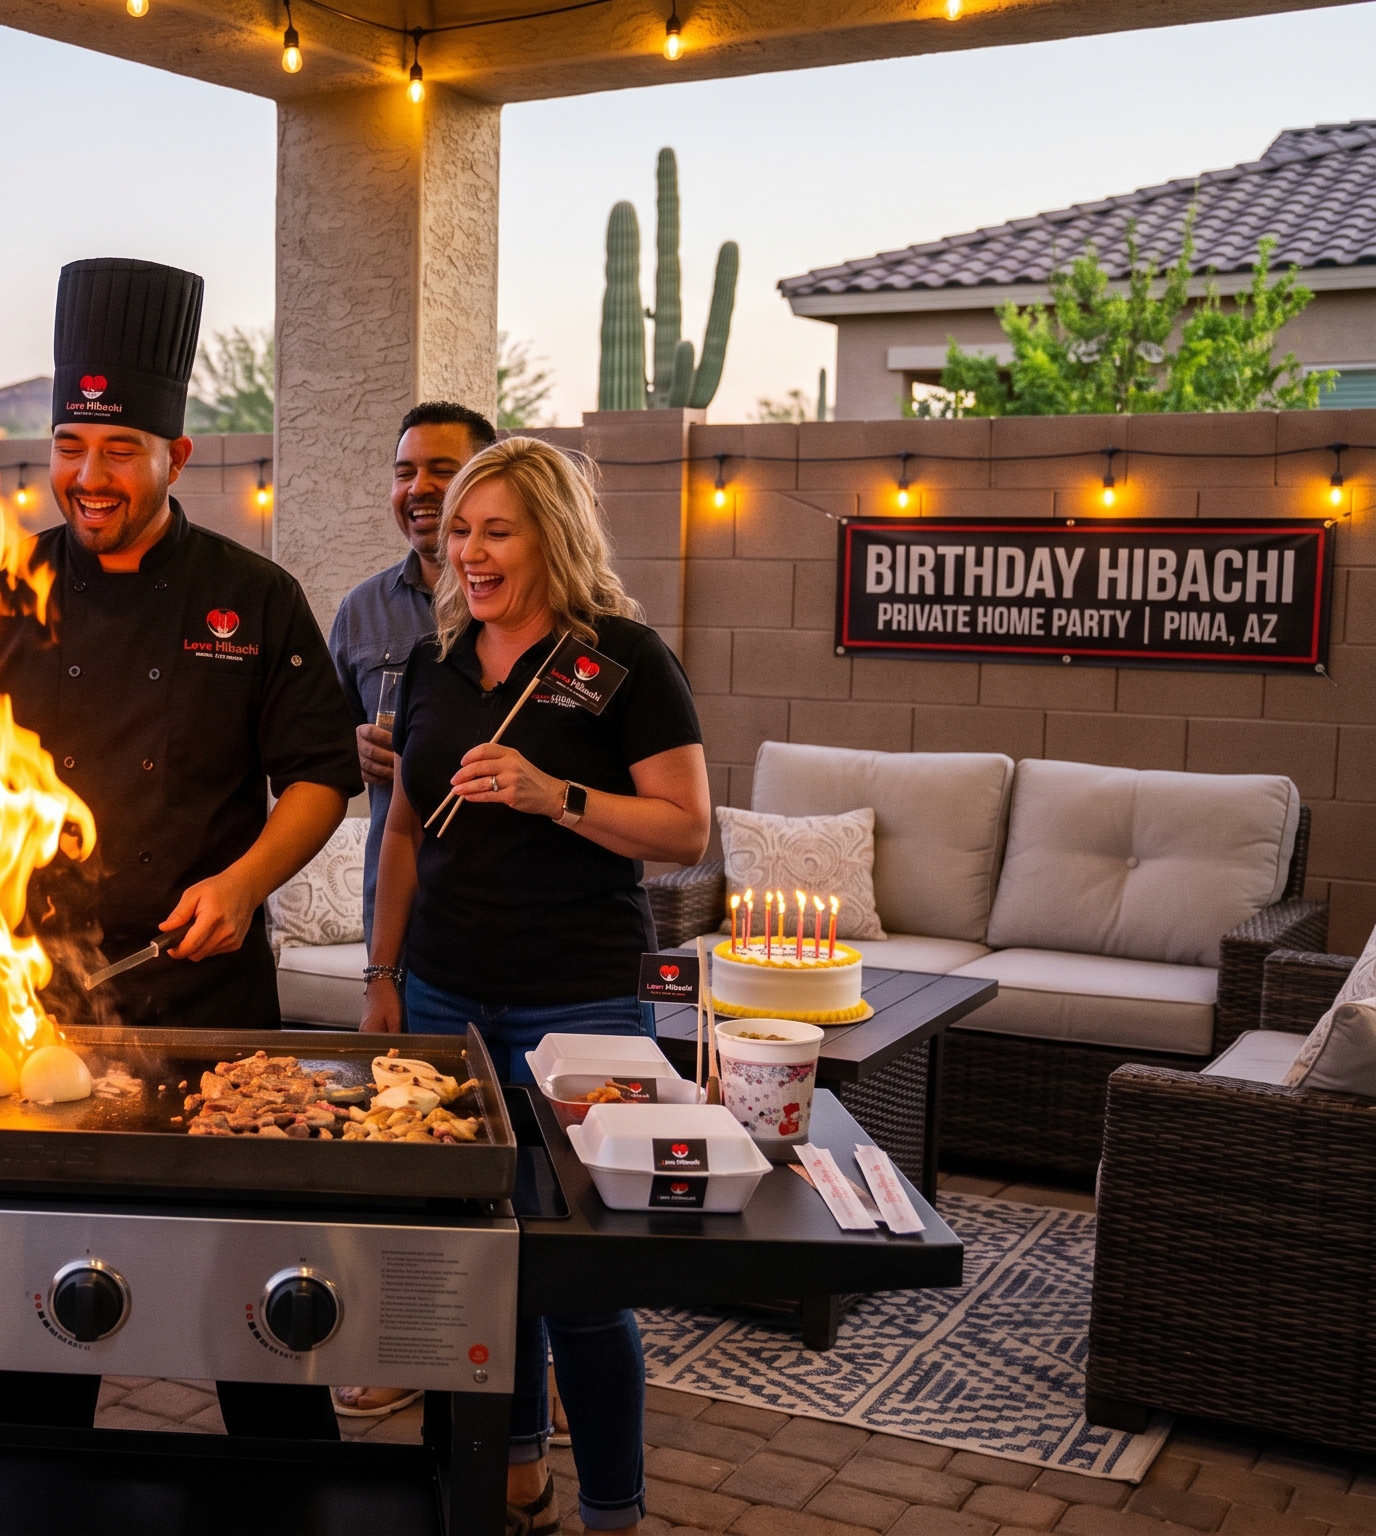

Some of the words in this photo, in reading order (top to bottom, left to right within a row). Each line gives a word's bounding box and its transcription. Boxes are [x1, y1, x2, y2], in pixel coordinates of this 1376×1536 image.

[865, 544, 1085, 599] BIRTHDAY
[1097, 547, 1296, 604] HIBACHI
[877, 602, 971, 634] PRIVATE
[977, 605, 1046, 636] HOME
[1051, 608, 1132, 640] PARTY
[1163, 611, 1236, 646] PIMA,
[1243, 613, 1278, 644] AZ
